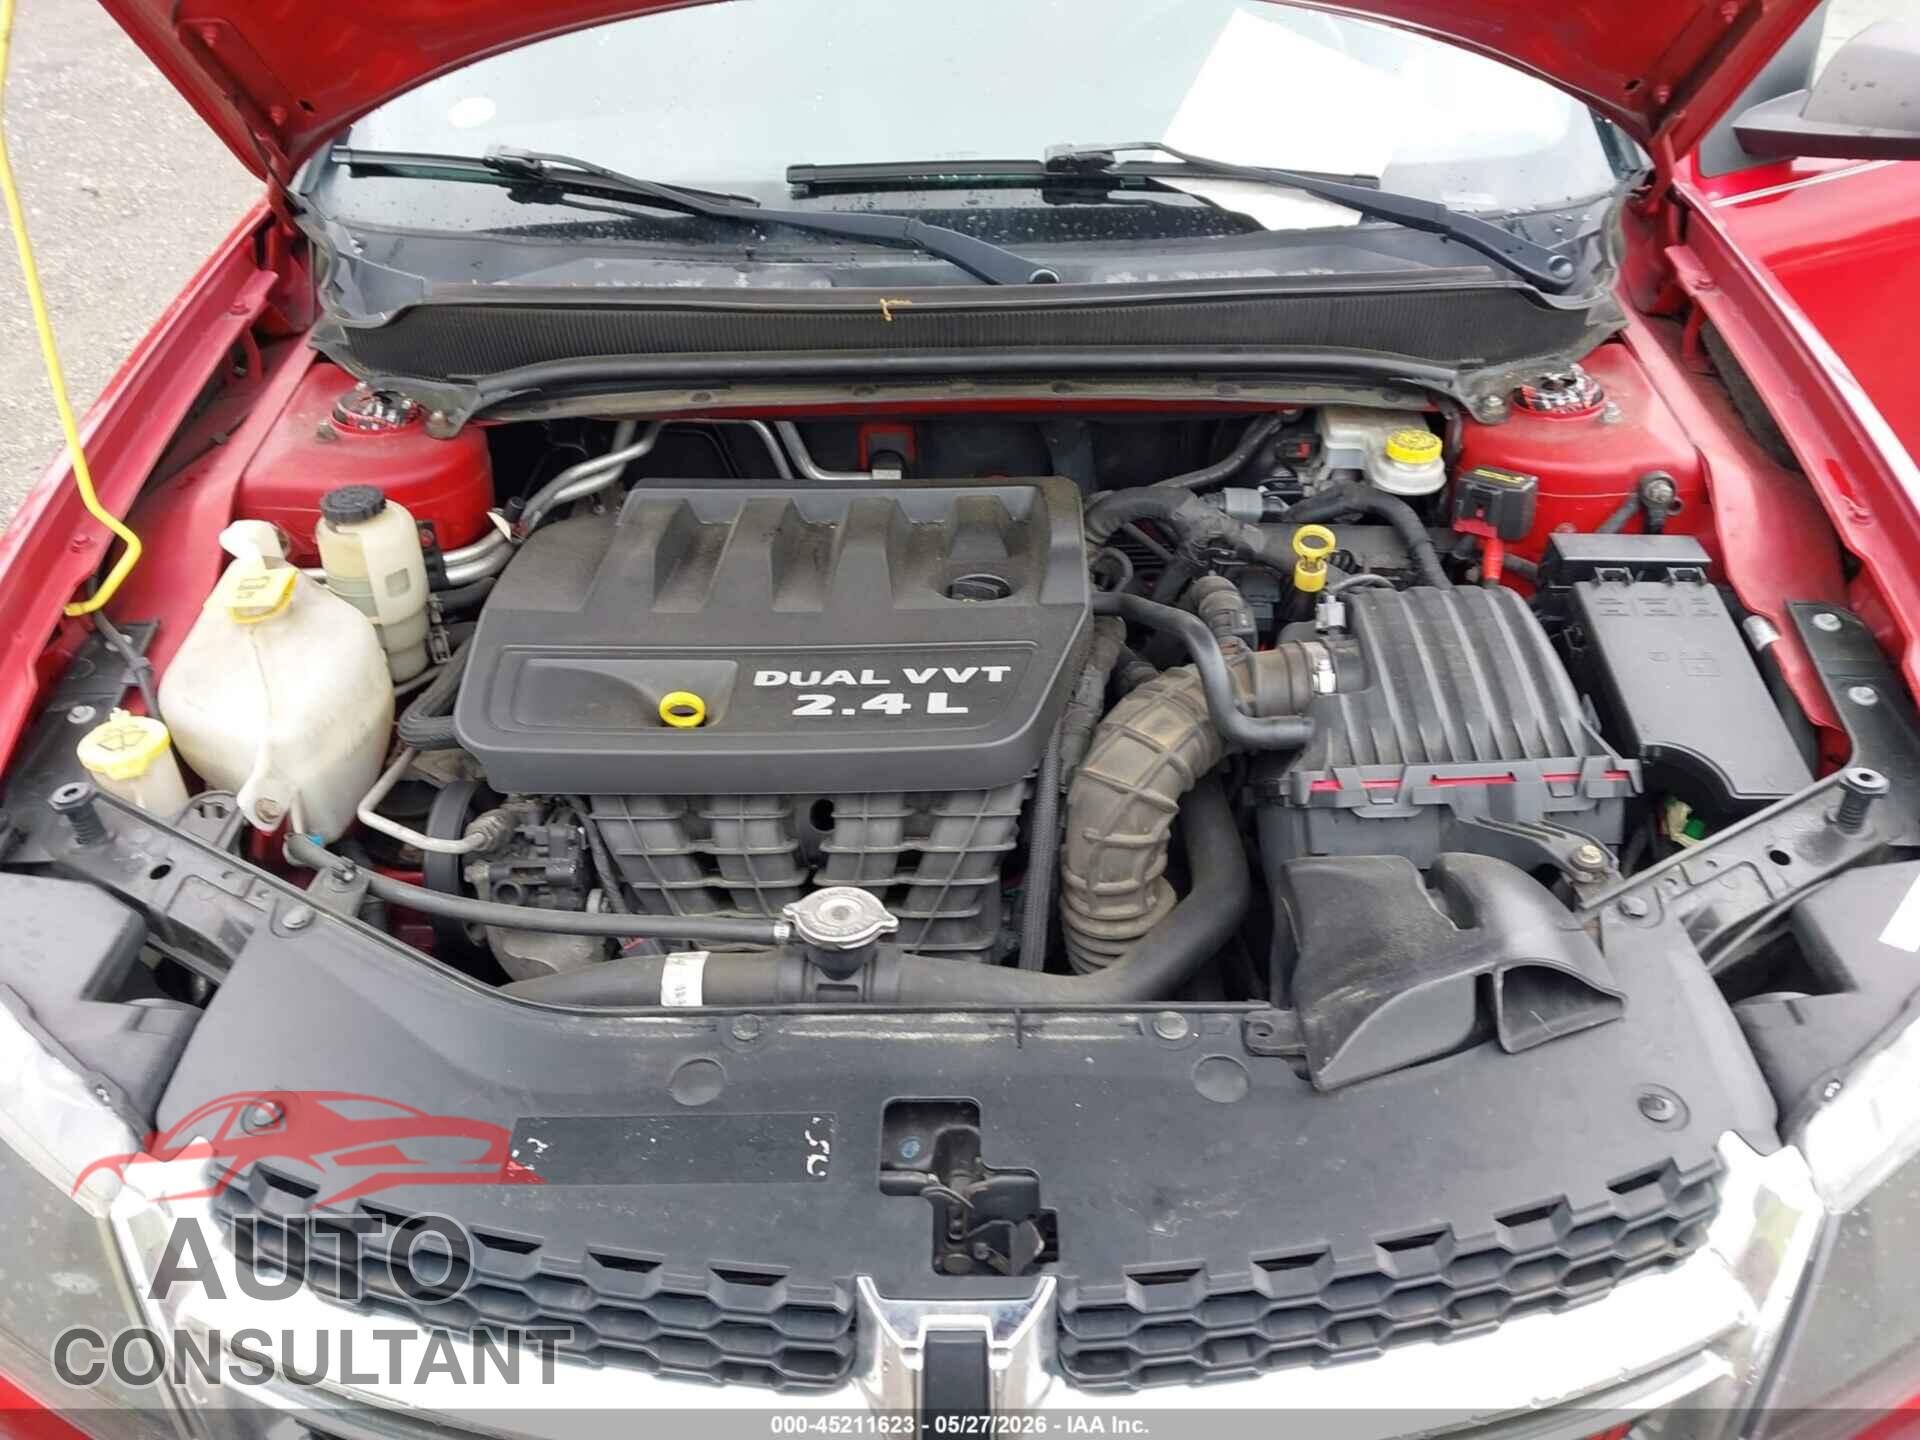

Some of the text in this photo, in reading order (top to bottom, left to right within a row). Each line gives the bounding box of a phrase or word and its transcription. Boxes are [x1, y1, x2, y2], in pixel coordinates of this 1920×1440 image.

[753, 665, 1011, 686] DUAL VVT
[792, 692, 969, 716] 2.4 L
